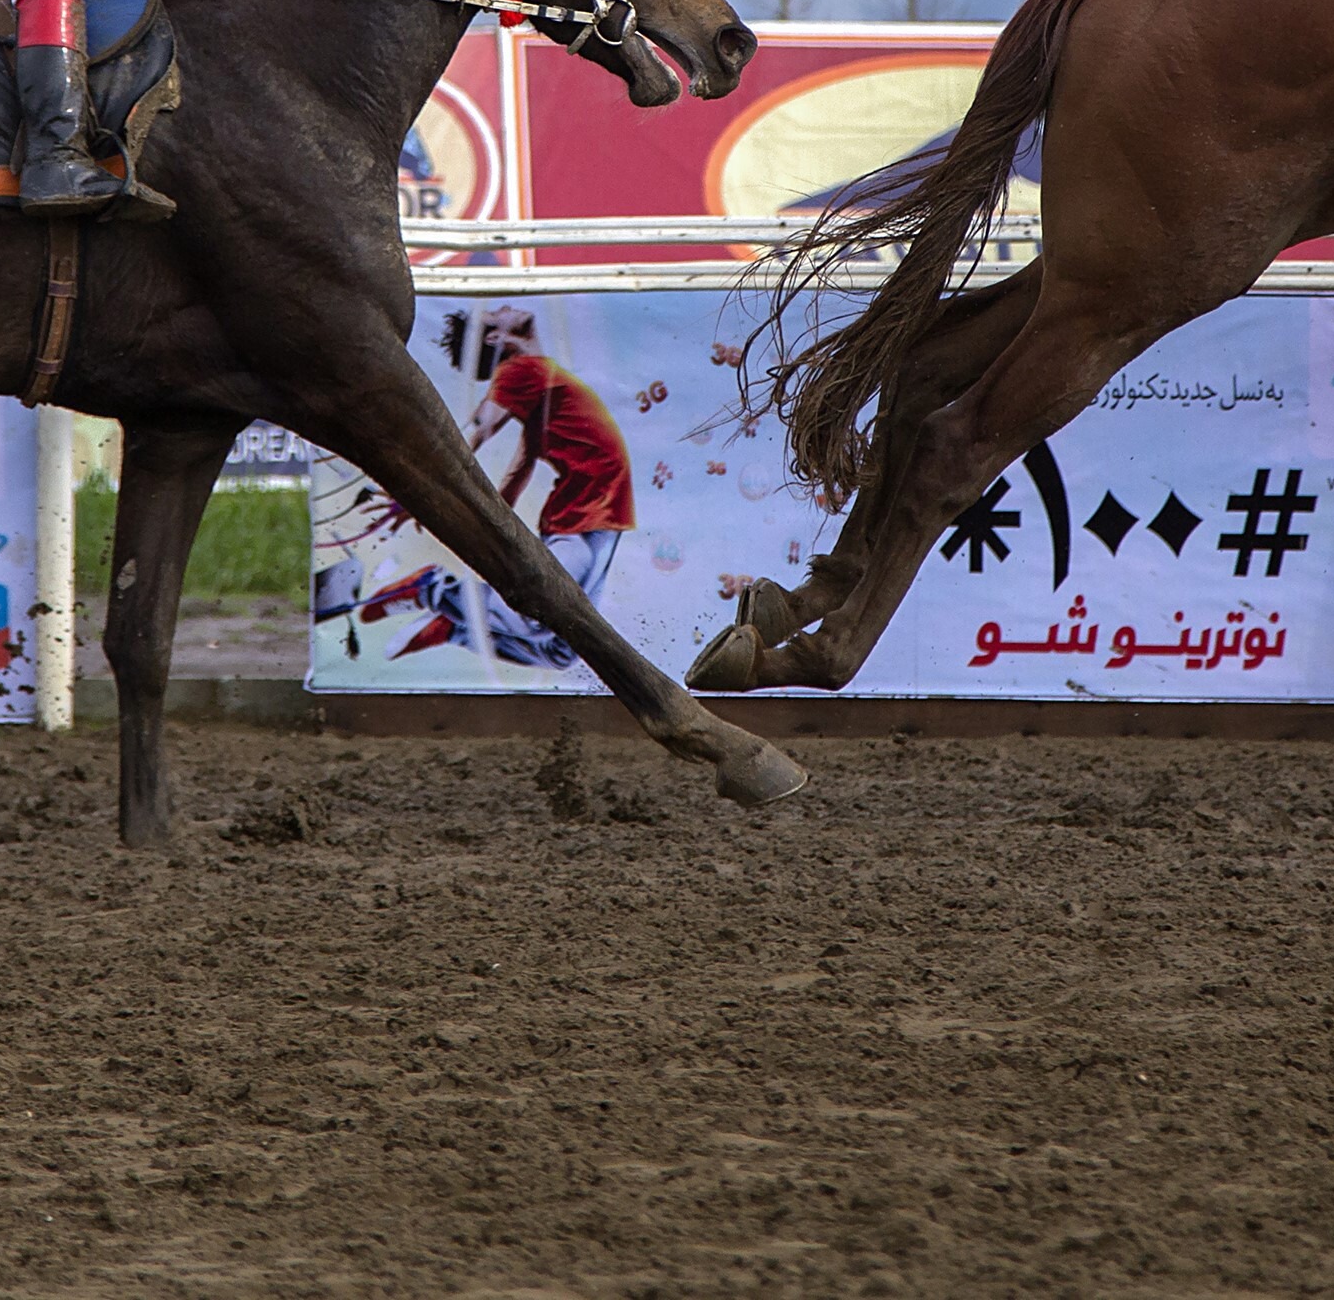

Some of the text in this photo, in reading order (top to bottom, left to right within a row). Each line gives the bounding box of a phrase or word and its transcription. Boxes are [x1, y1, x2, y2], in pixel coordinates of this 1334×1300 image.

[636, 380, 669, 413] 3G
[1170, 381, 1218, 408] جدید
[1219, 373, 1264, 411] نسل
[1265, 383, 1284, 408] به
[967, 594, 1288, 671] نوترینو شو
